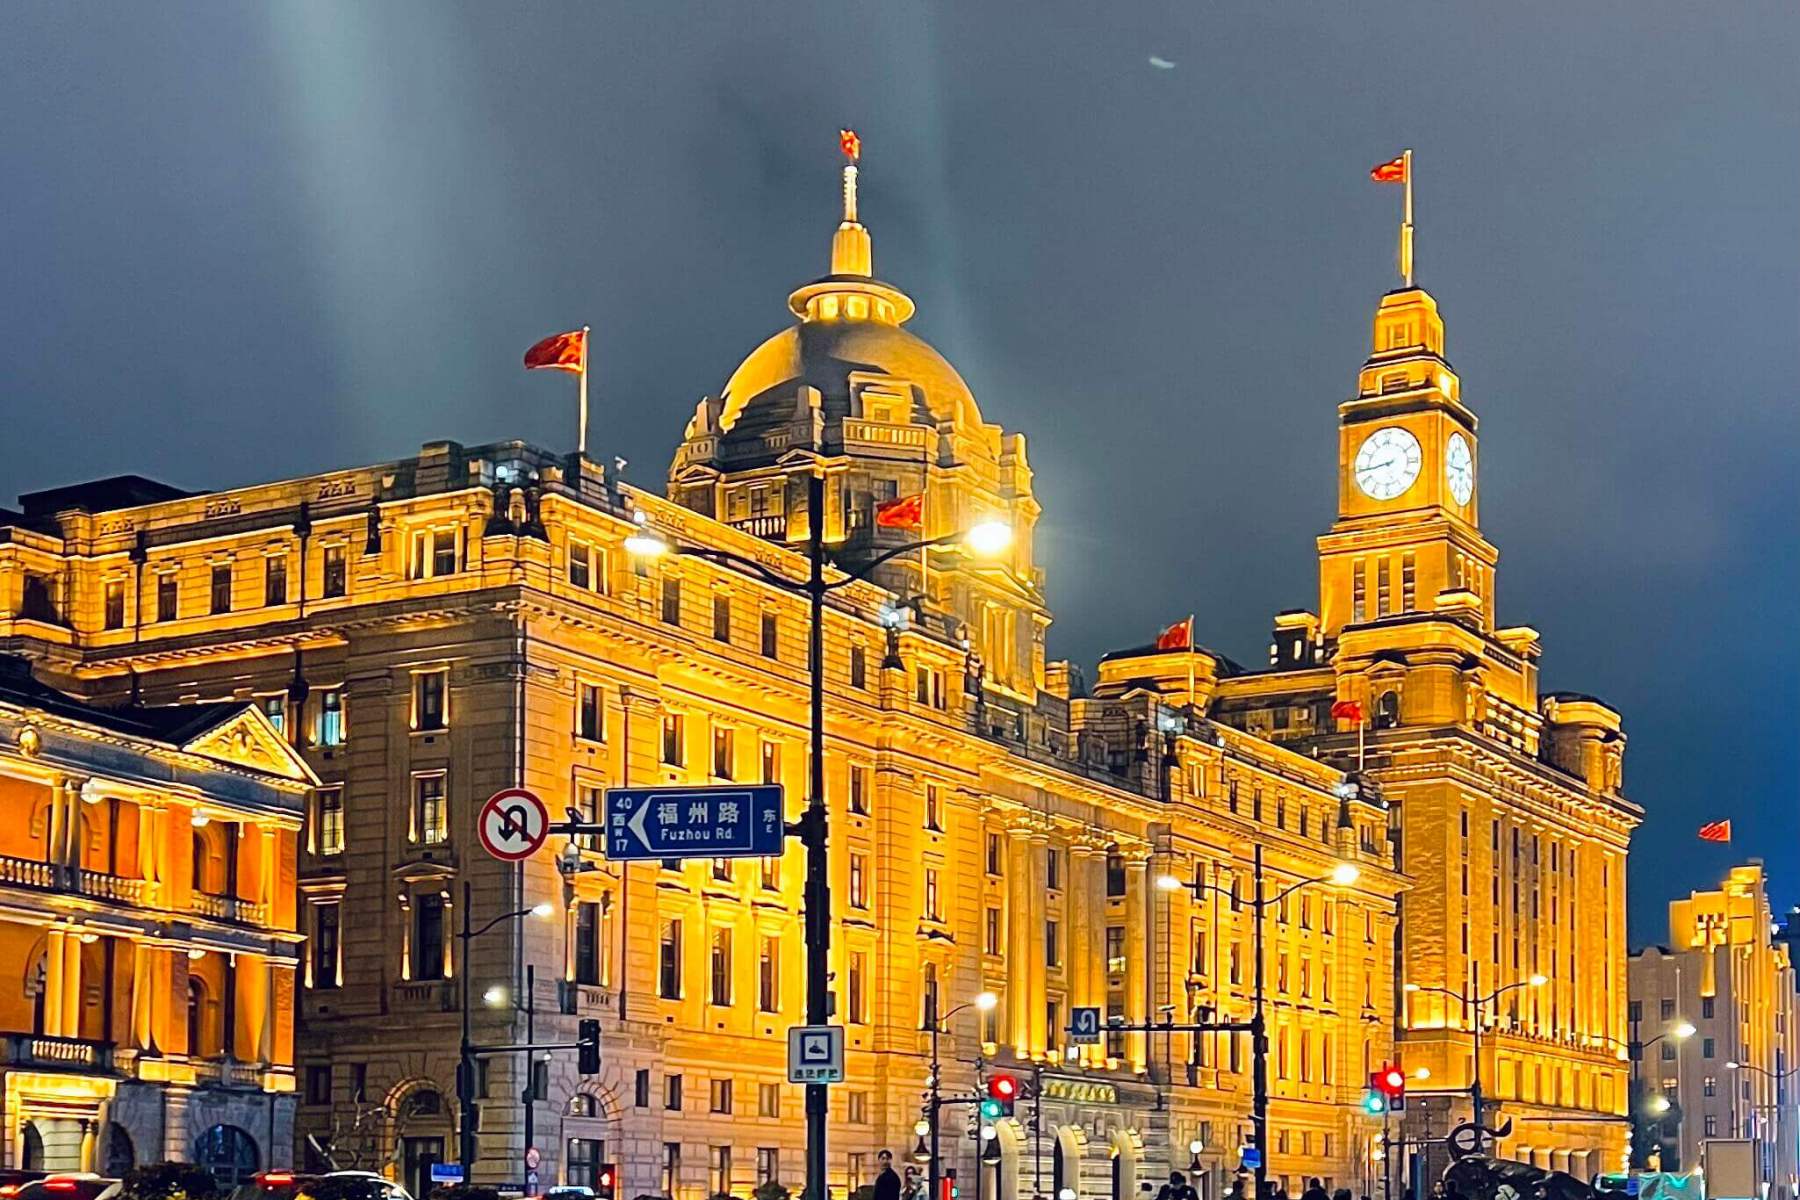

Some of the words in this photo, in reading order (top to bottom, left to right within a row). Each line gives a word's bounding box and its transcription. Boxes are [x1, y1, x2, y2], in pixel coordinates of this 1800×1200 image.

[616, 797, 632, 809] 40
[657, 802, 739, 824] 福州路
[763, 808, 777, 822] 东
[612, 813, 626, 826] 西
[661, 828, 710, 840] Fuzhou
[766, 824, 773, 833] E
[616, 839, 628, 851] 17
